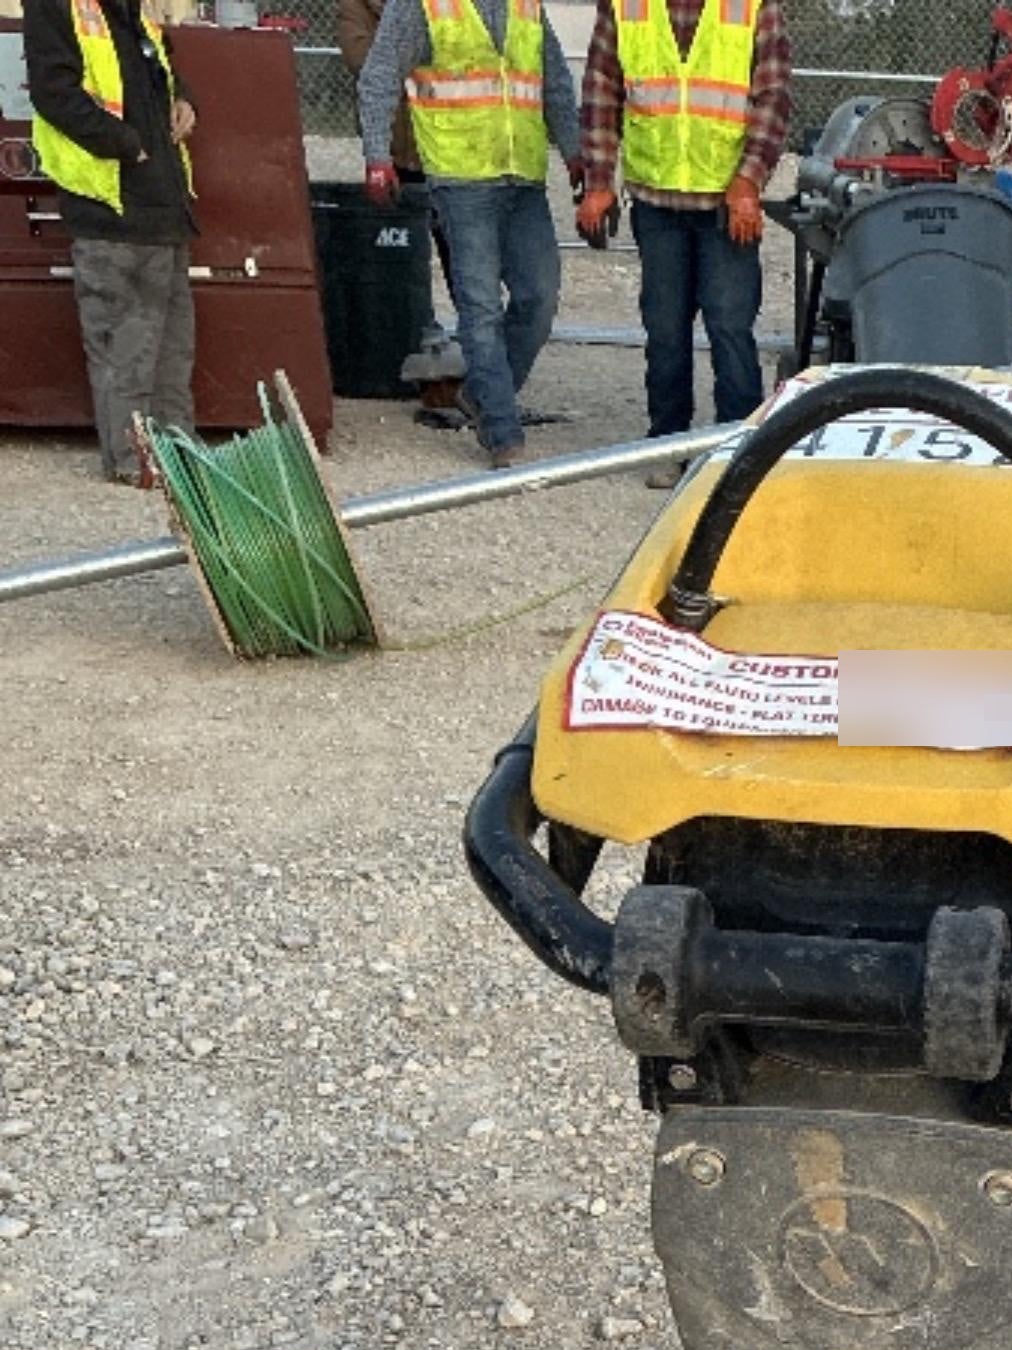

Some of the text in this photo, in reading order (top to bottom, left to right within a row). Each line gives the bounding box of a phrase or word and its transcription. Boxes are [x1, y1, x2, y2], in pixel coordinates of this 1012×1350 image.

[375, 227, 409, 247] ACE
[729, 660, 839, 679] CUSTO
[663, 707, 687, 722] TO
